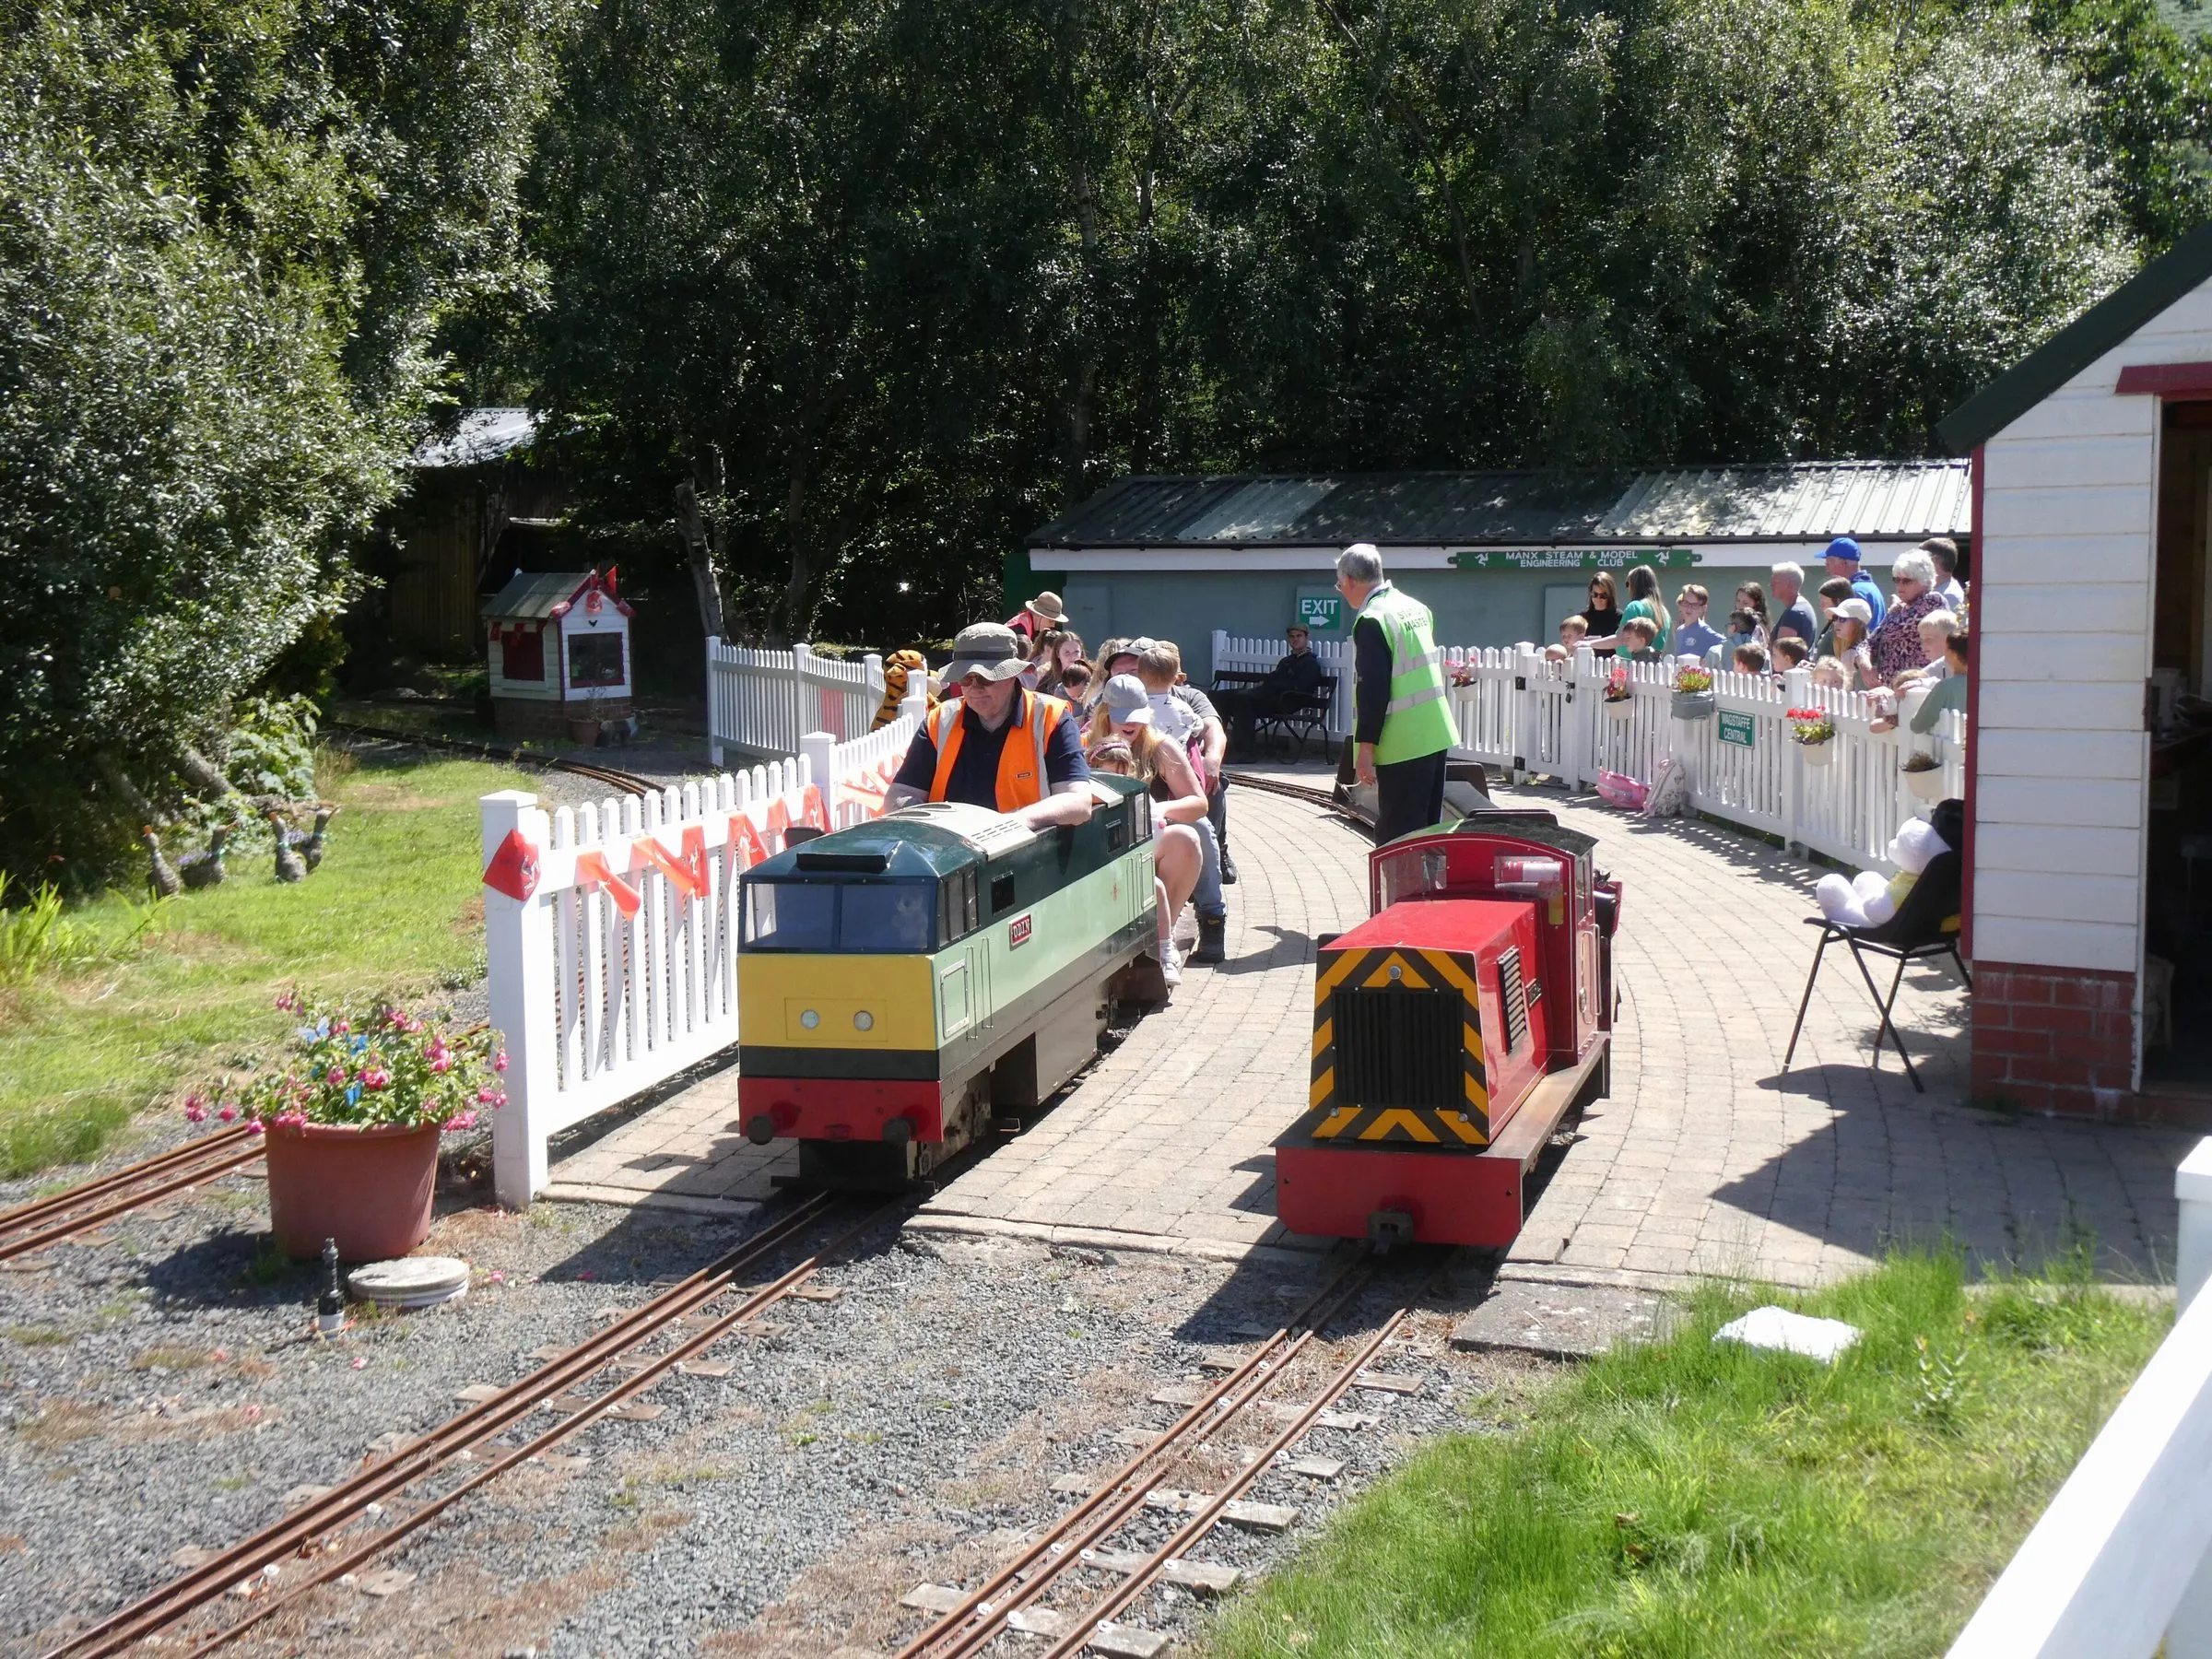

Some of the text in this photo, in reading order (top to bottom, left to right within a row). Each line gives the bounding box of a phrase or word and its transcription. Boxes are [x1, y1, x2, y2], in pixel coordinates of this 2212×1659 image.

[1505, 550, 1638, 559] MANX STEAM & MODEL
[1520, 559, 1624, 568] ENGINEERING CLUB
[1301, 599, 1338, 615] EXIT
[1721, 712, 1750, 730] WAGSTAFFE
[1724, 727, 1747, 744] CENTRAL
[1013, 918, 1030, 938] ODIN
